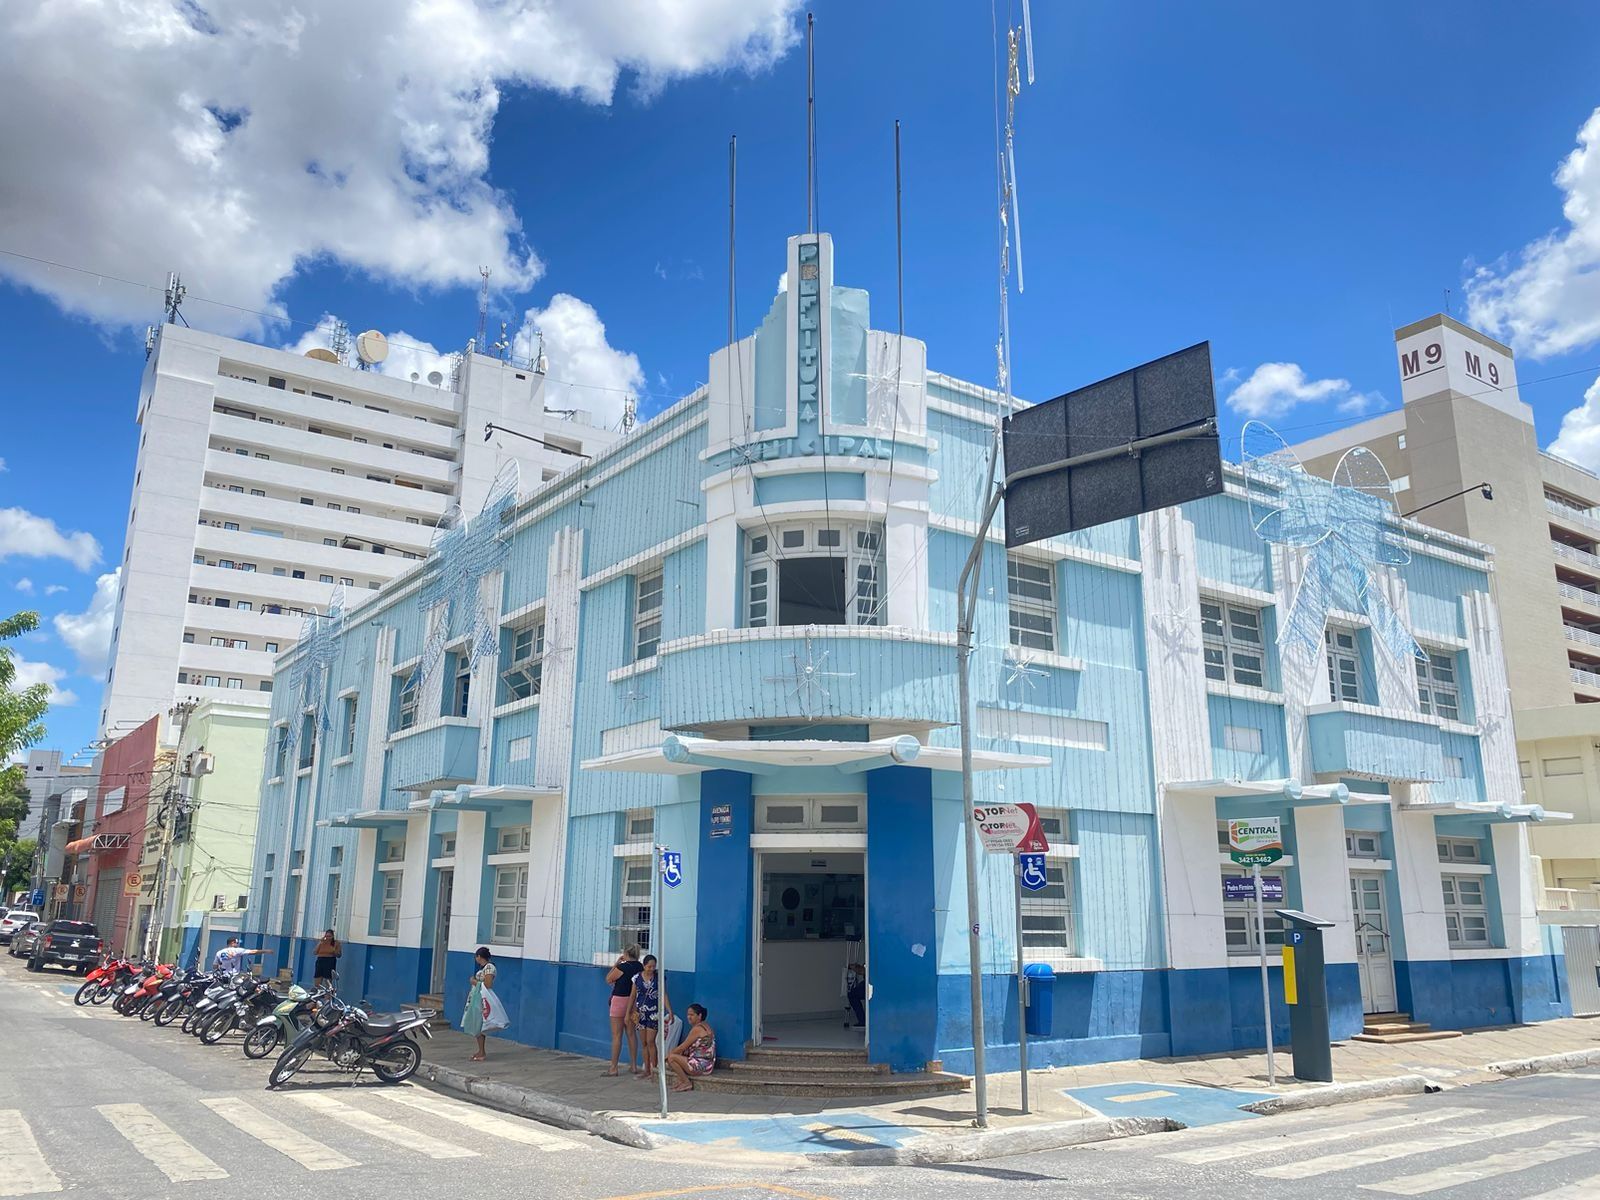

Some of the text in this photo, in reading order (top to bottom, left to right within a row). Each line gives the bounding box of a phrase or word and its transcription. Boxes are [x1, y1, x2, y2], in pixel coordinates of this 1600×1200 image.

[800, 244, 817, 423] PREFEITURA
[1238, 826, 1278, 835] CENTRAL
[1293, 933, 1301, 944] P
